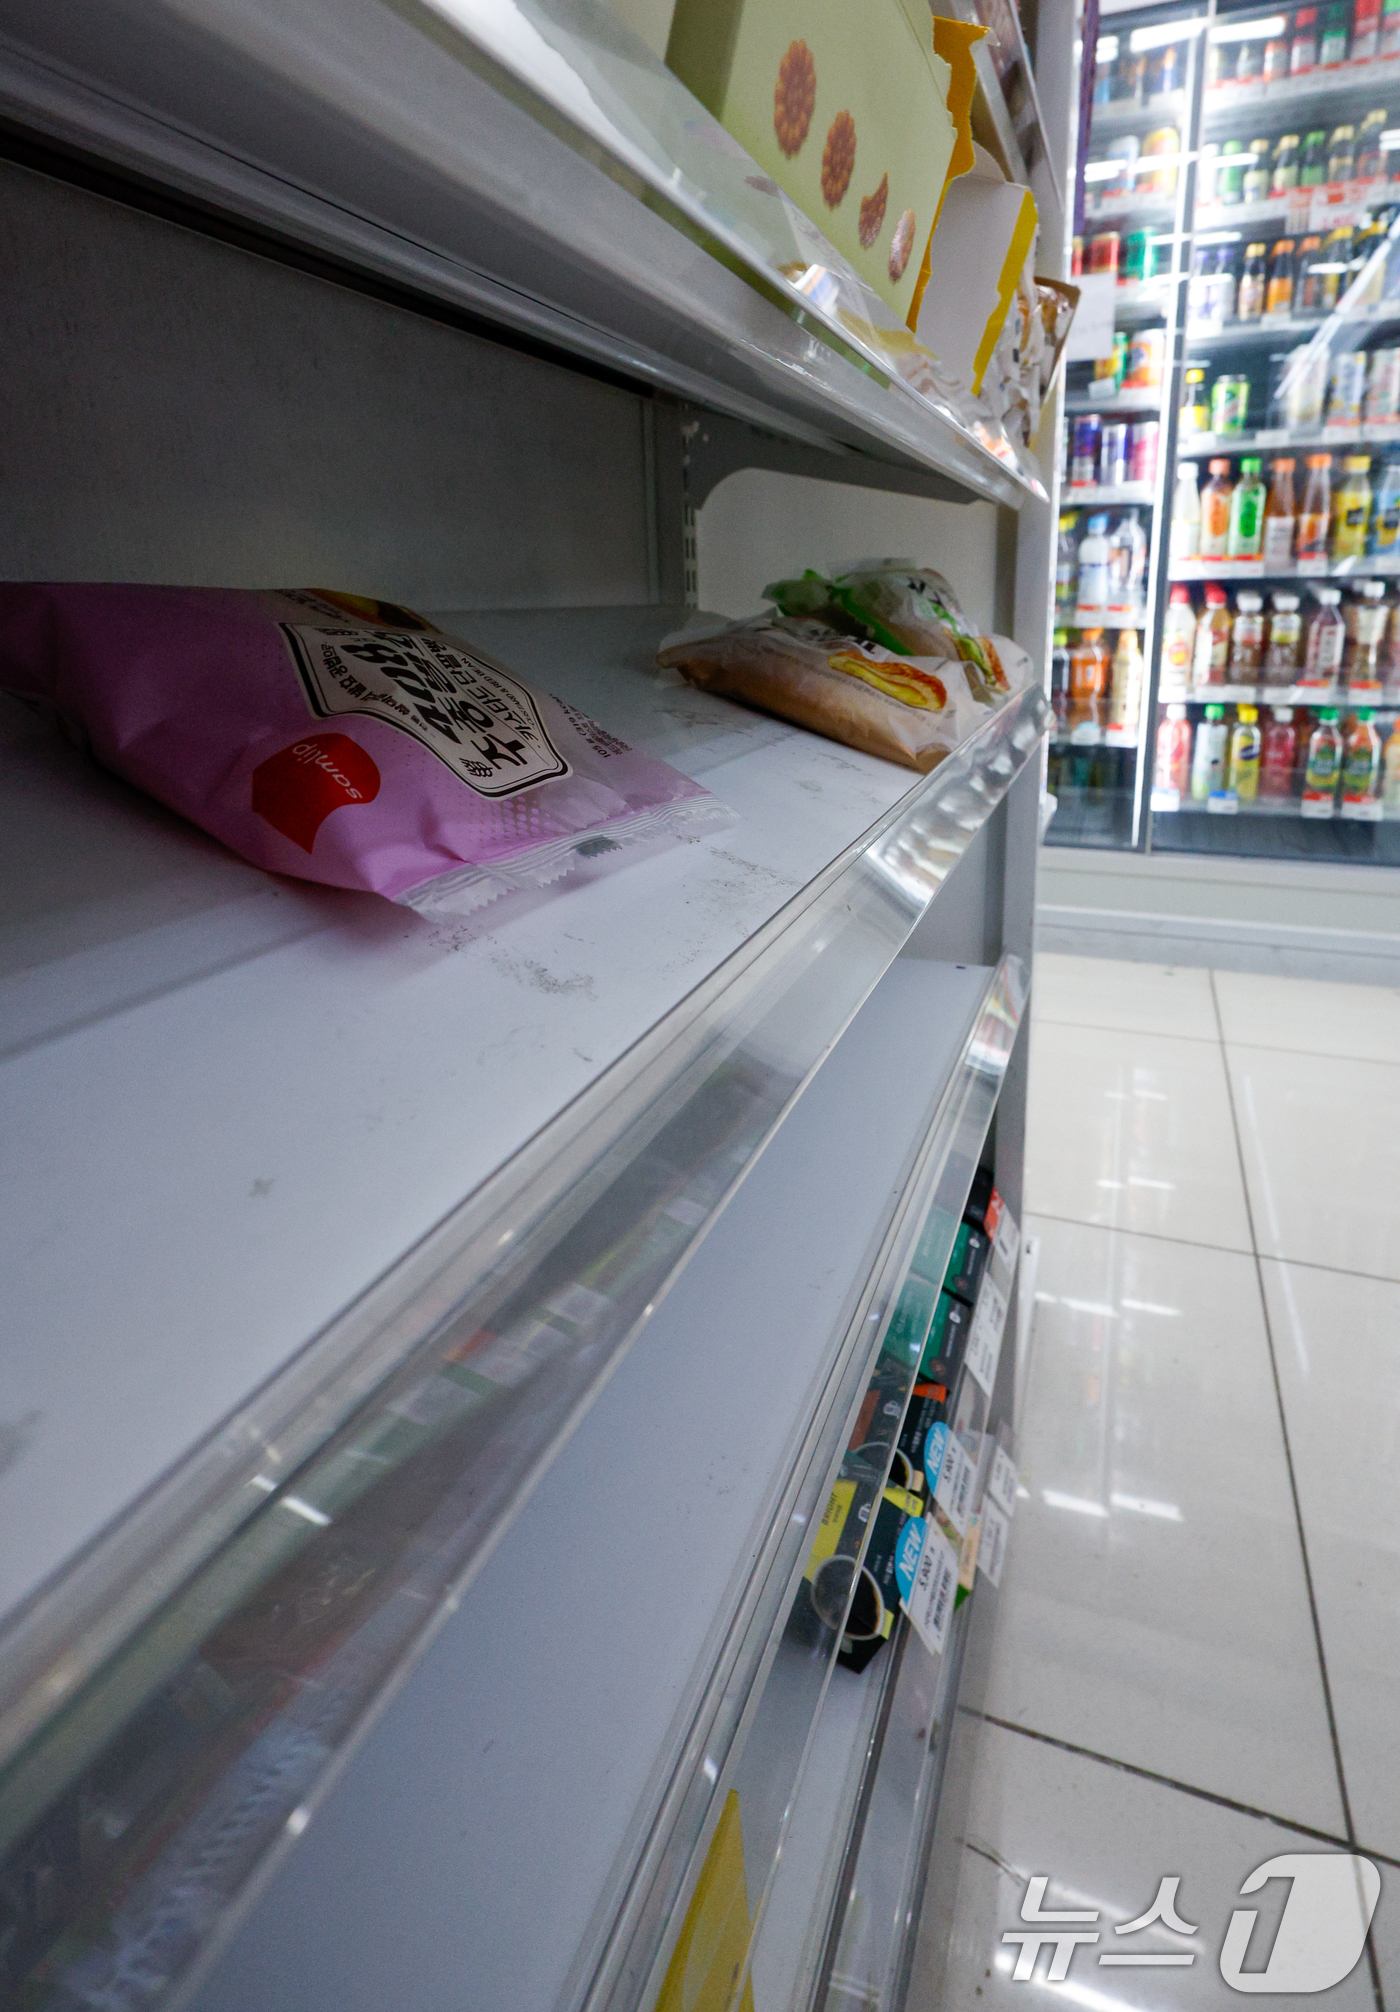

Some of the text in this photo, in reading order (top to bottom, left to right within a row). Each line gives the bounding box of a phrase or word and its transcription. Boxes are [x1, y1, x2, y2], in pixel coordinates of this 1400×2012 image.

[321, 643, 349, 678] 공법으로
[421, 637, 477, 686] 단팥빵
[460, 657, 484, 677] BEAN
[338, 674, 368, 699] 발효
[483, 674, 502, 691] RED
[468, 685, 538, 742] 카스타드
[291, 740, 364, 800] samlip
[592, 744, 612, 759] 105
[926, 1426, 946, 1477] NEW
[898, 1521, 924, 1582] NEW
